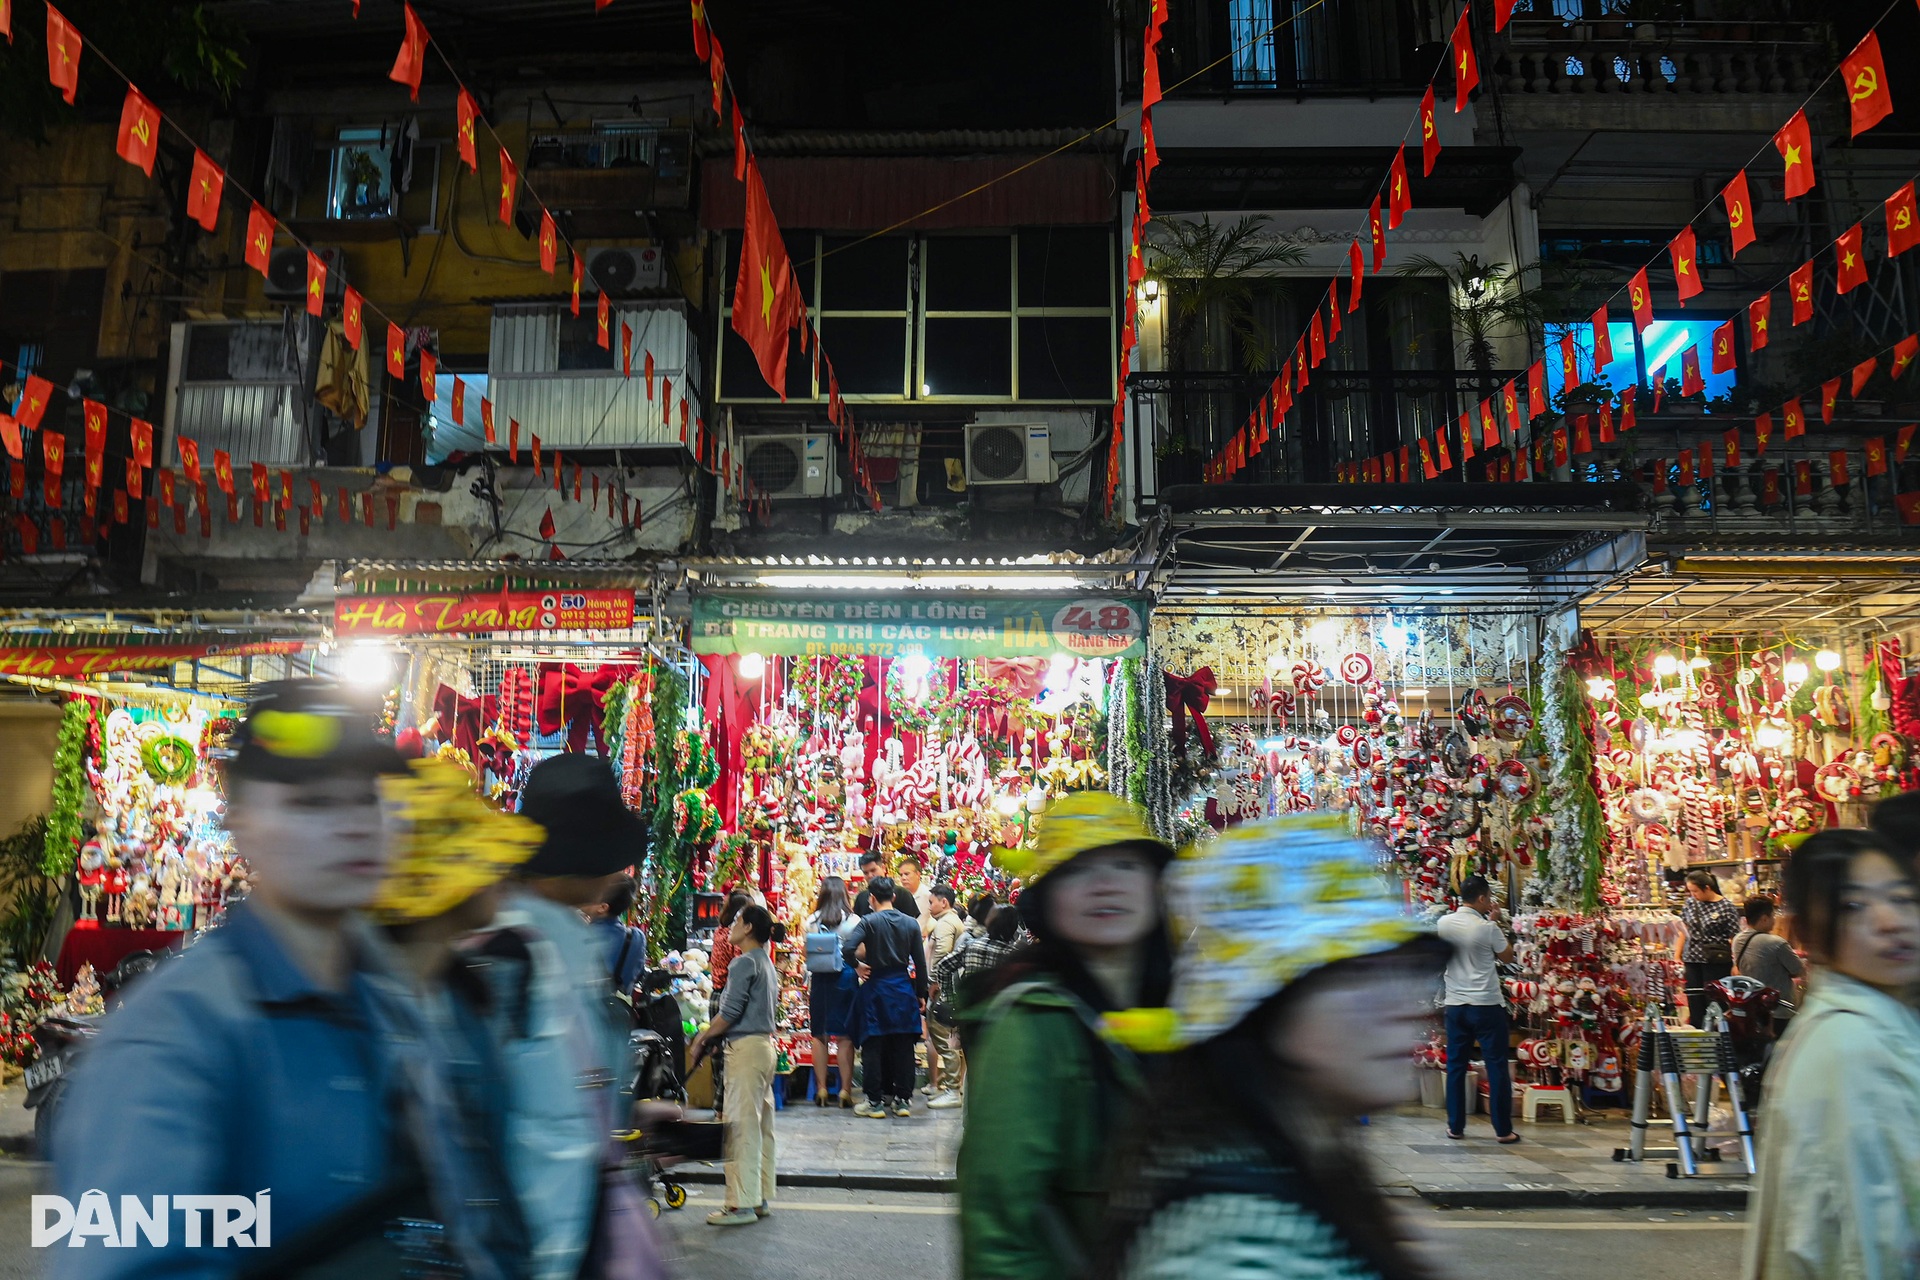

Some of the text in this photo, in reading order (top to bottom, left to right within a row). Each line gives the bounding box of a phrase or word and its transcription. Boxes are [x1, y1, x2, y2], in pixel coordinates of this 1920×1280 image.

[560, 593, 586, 610] 50
[587, 598, 611, 610] Hàng
[722, 600, 834, 619] CHUYÊN
[844, 601, 902, 619] ĐÈN
[339, 597, 538, 631] Hà Trang
[560, 609, 627, 619] 0912 430 169
[1062, 606, 1130, 630] 48
[745, 622, 826, 639] TRANG
[834, 622, 873, 640] TRÍ
[881, 622, 931, 641] CÁC
[940, 625, 996, 643] LOẠI
[1003, 610, 1050, 648] HÀ
[868, 642, 894, 655] 372
